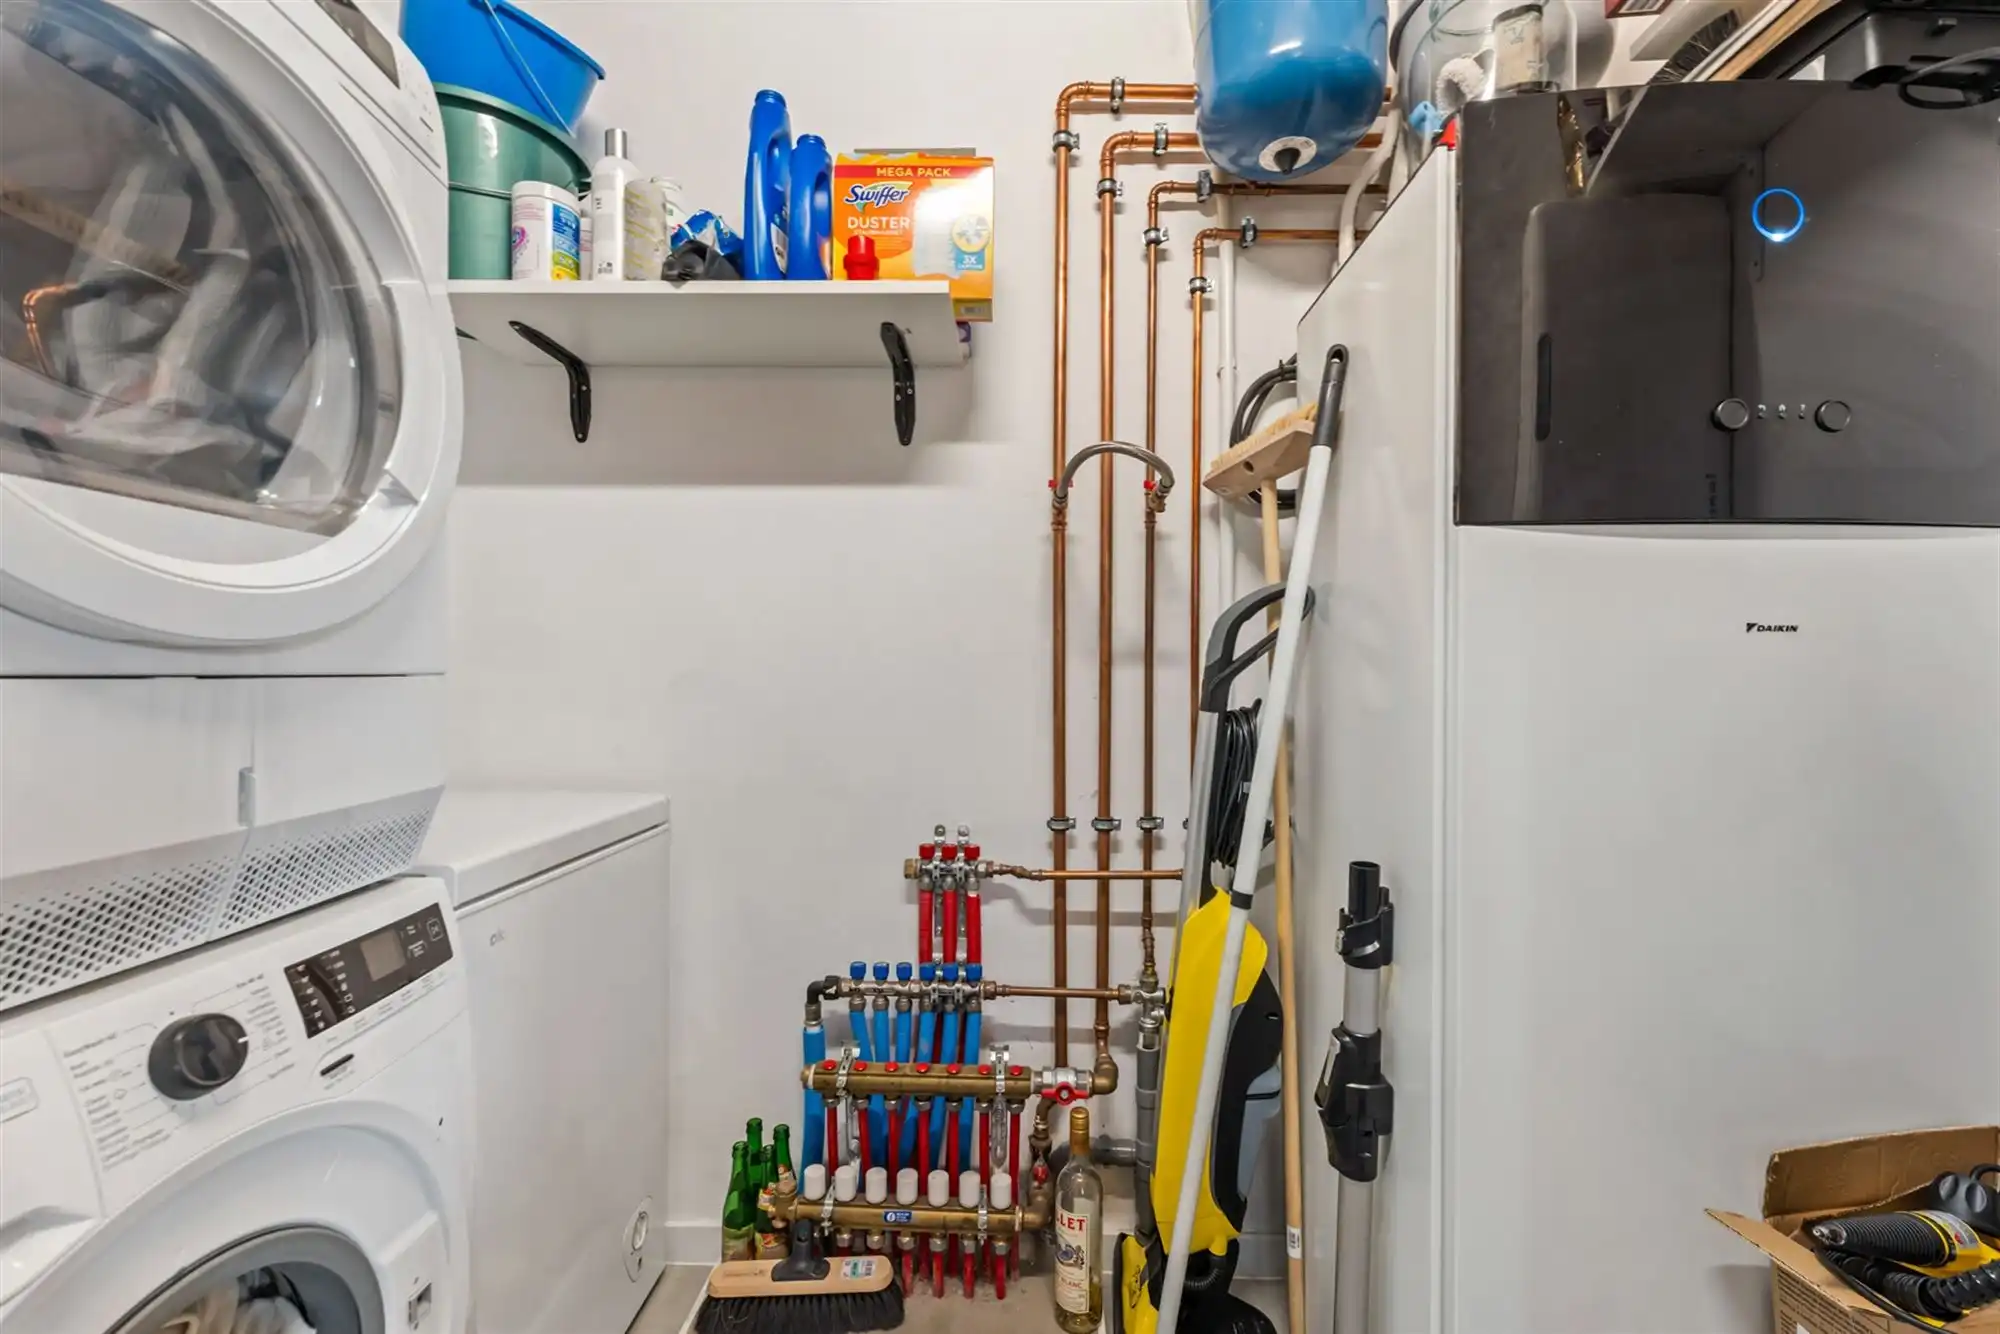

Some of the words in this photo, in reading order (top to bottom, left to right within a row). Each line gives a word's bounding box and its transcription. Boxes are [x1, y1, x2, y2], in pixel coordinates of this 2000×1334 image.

[876, 167, 914, 177] MEGA
[917, 167, 951, 177] PACK
[845, 184, 909, 207] Swiffer
[847, 216, 911, 229] DUSTER
[1757, 624, 1799, 633] DAIKIN
[1057, 1212, 1086, 1231] LET
